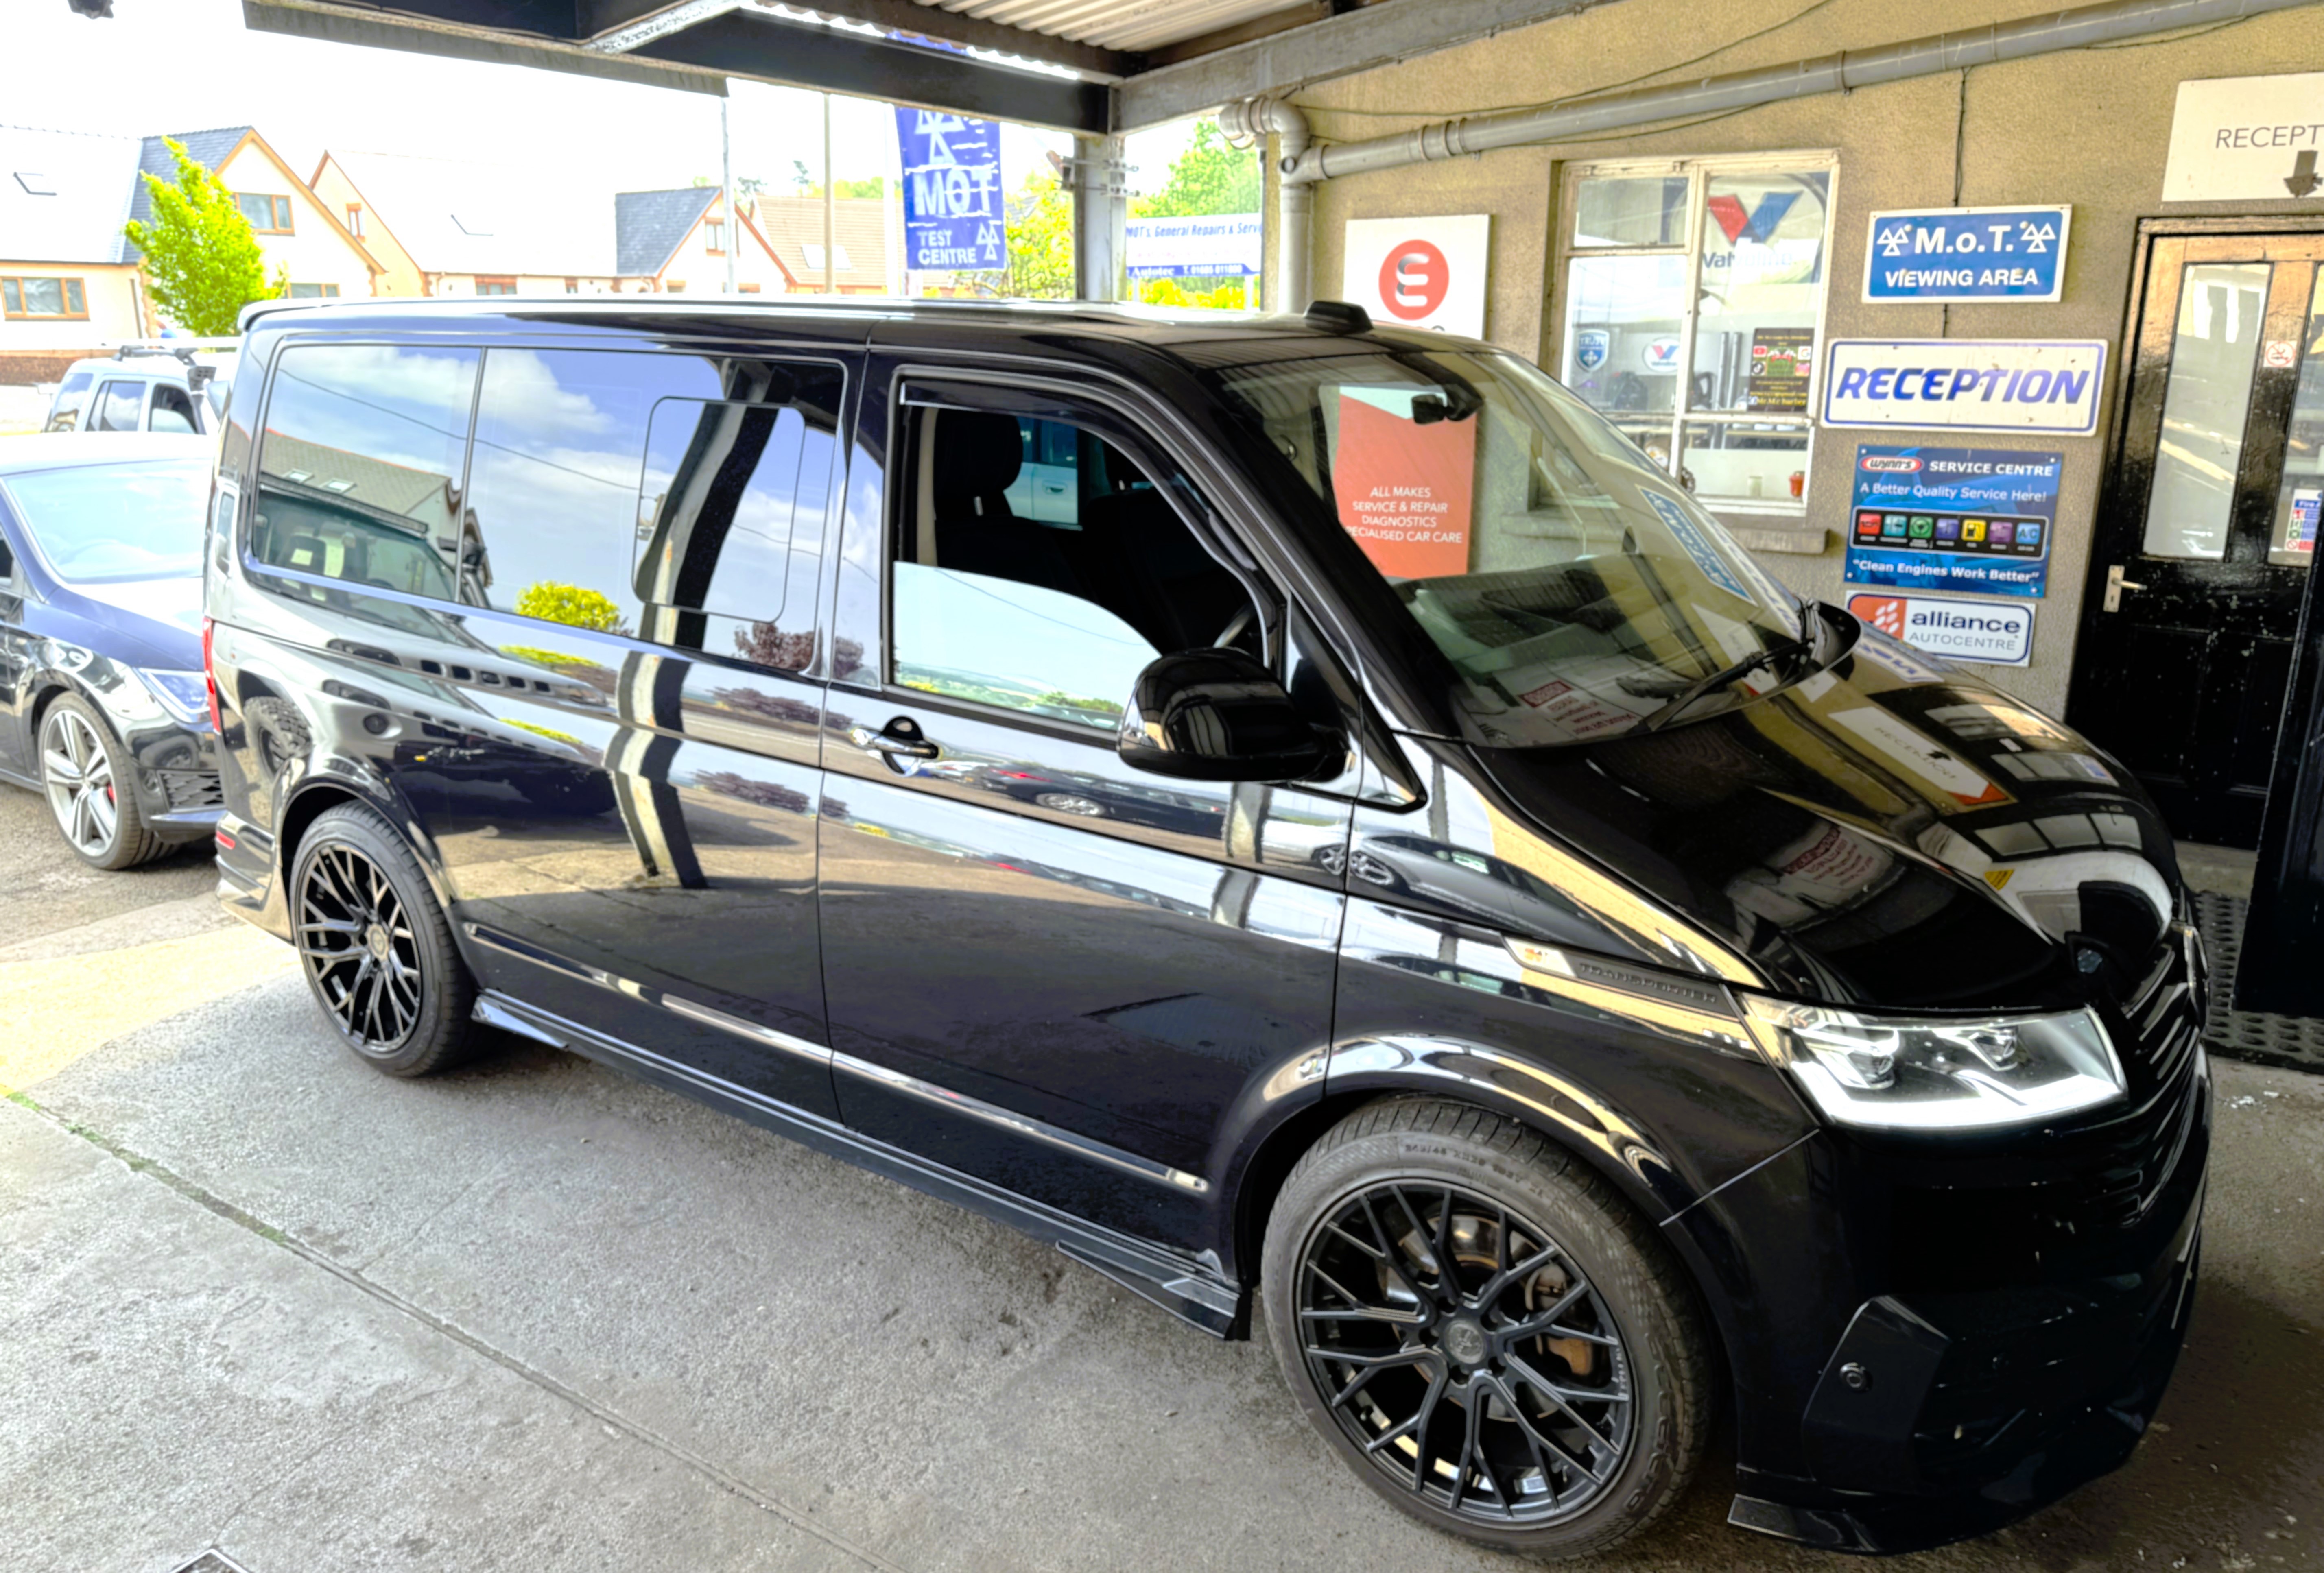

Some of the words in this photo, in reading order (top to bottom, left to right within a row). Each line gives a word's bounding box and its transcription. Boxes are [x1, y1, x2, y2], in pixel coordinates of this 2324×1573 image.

[2216, 124, 2324, 148] RECEPT
[914, 168, 993, 216] MOT
[917, 229, 952, 247] TEST
[1155, 225, 1189, 237] General
[1192, 224, 1225, 236] Repairs
[1914, 225, 2014, 254] M.o.T.
[918, 247, 977, 265] CENTRE
[1885, 269, 1973, 287] VIEWING
[1979, 268, 2038, 286] AREA
[1835, 367, 2090, 404] RECEPTION
[1929, 460, 1992, 474] SERVICE
[1995, 463, 2053, 477] CENTRE
[1370, 486, 1390, 498] ALL
[1393, 486, 1431, 498] MAKES
[1860, 482, 1870, 493] A
[1872, 483, 1910, 496] Better
[1913, 486, 1957, 500] Quality
[1960, 487, 2007, 500] Service
[2012, 490, 2047, 502] Here!
[1352, 501, 1397, 513] SERVICE
[1399, 501, 1407, 513] &
[1410, 502, 1448, 513] REPAIR
[1361, 515, 1437, 528] DIAGNOSTICS
[1345, 526, 1404, 541] PECIALISED
[1407, 531, 1431, 542] CAR
[1432, 532, 1463, 543] CARE
[1852, 559, 1894, 572] "Clean
[1897, 562, 1948, 578] Engines
[1951, 566, 1986, 580] Work
[1911, 611, 2021, 634] alliance
[1909, 631, 2016, 651] AUTOCENTRE
